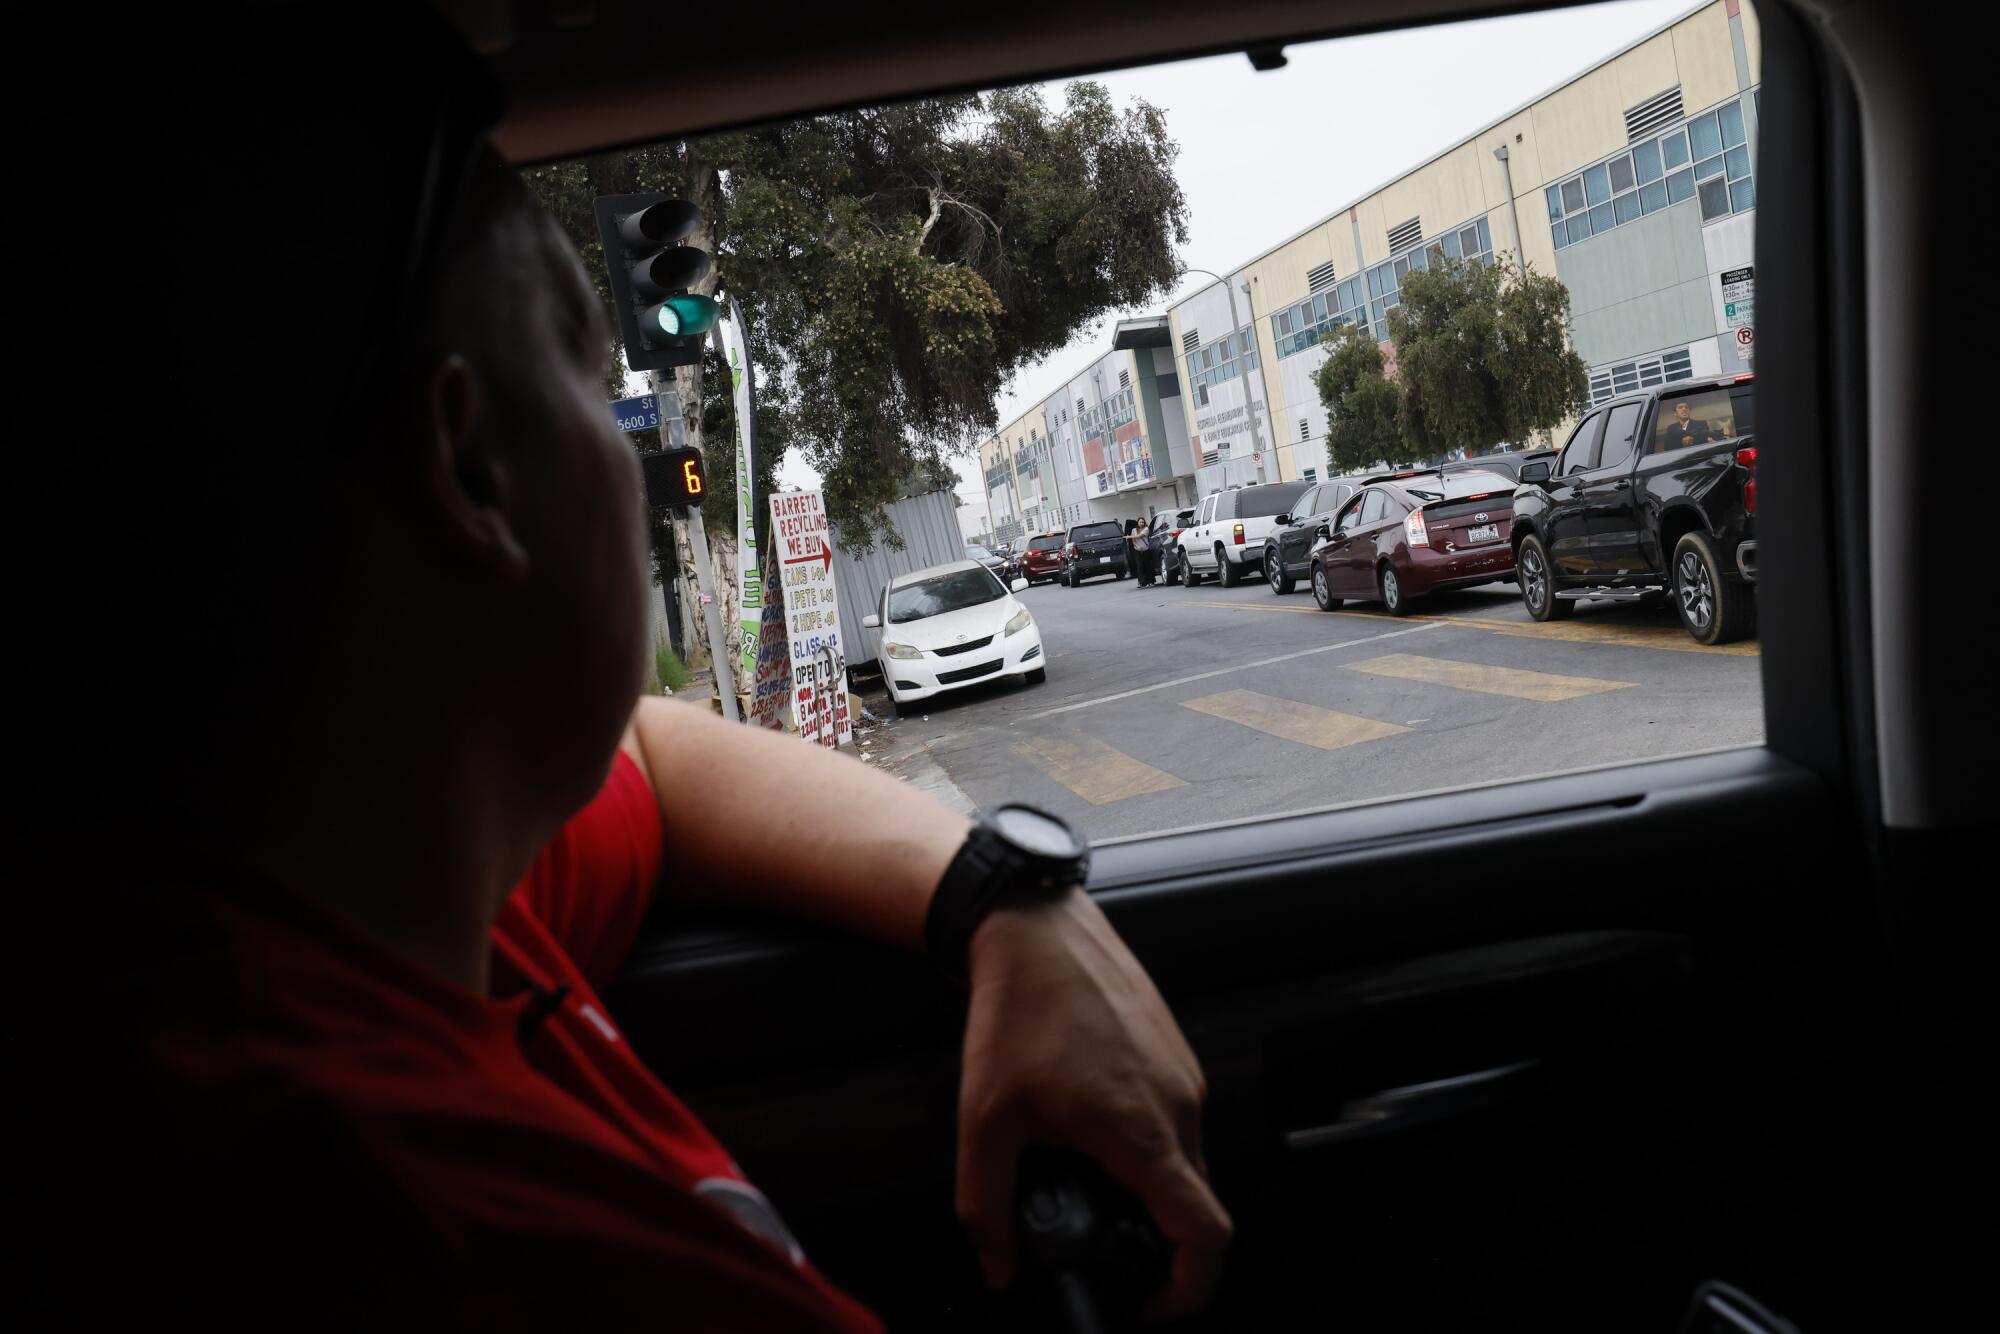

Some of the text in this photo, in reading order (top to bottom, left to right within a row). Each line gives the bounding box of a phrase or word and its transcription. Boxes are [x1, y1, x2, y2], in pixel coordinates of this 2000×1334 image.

[1728, 306, 1734, 315] 2
[642, 397, 654, 409] St
[617, 413, 658, 431] 5600 S
[684, 460, 701, 493] 6
[773, 494, 818, 517] BARRETO
[780, 513, 827, 538] RECYCLING
[787, 535, 821, 555] WE BUY
[784, 567, 807, 586] CANS
[794, 588, 818, 609] PETE
[818, 661, 824, 679] 7
[800, 704, 806, 721] 8
